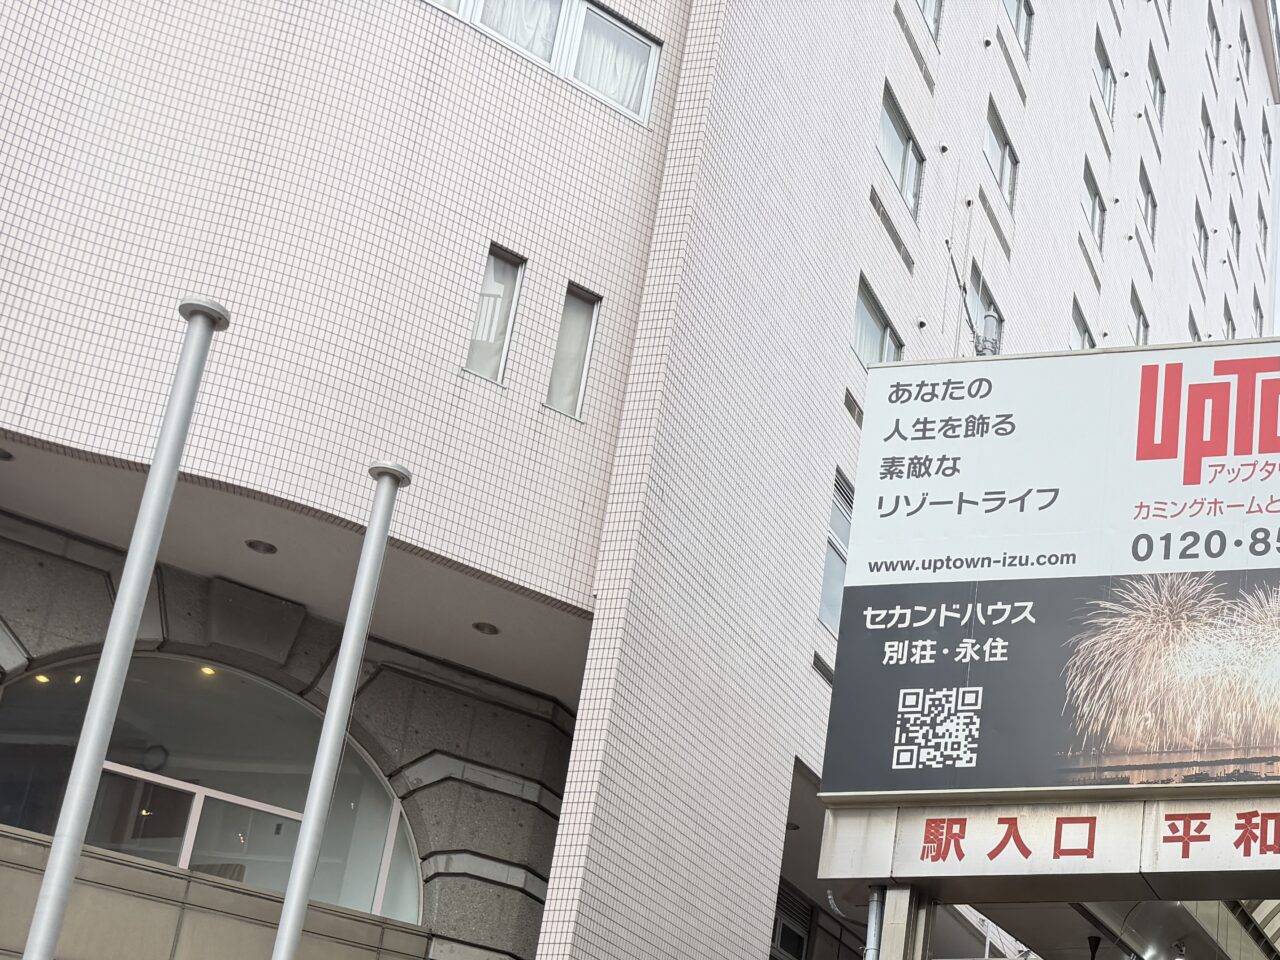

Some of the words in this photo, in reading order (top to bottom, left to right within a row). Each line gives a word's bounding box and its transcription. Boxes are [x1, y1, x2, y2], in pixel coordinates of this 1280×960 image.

[887, 377, 993, 404] あなたの
[883, 413, 1017, 442] 人生を飾る
[879, 453, 961, 481] 素敵な
[877, 487, 1060, 518] リゾートライフ
[868, 551, 1077, 573] www.uptown-izu.com
[862, 601, 1036, 630] セカンドハウス
[882, 637, 1009, 665] 別荘・永住
[919, 816, 1098, 863] 駅入口
